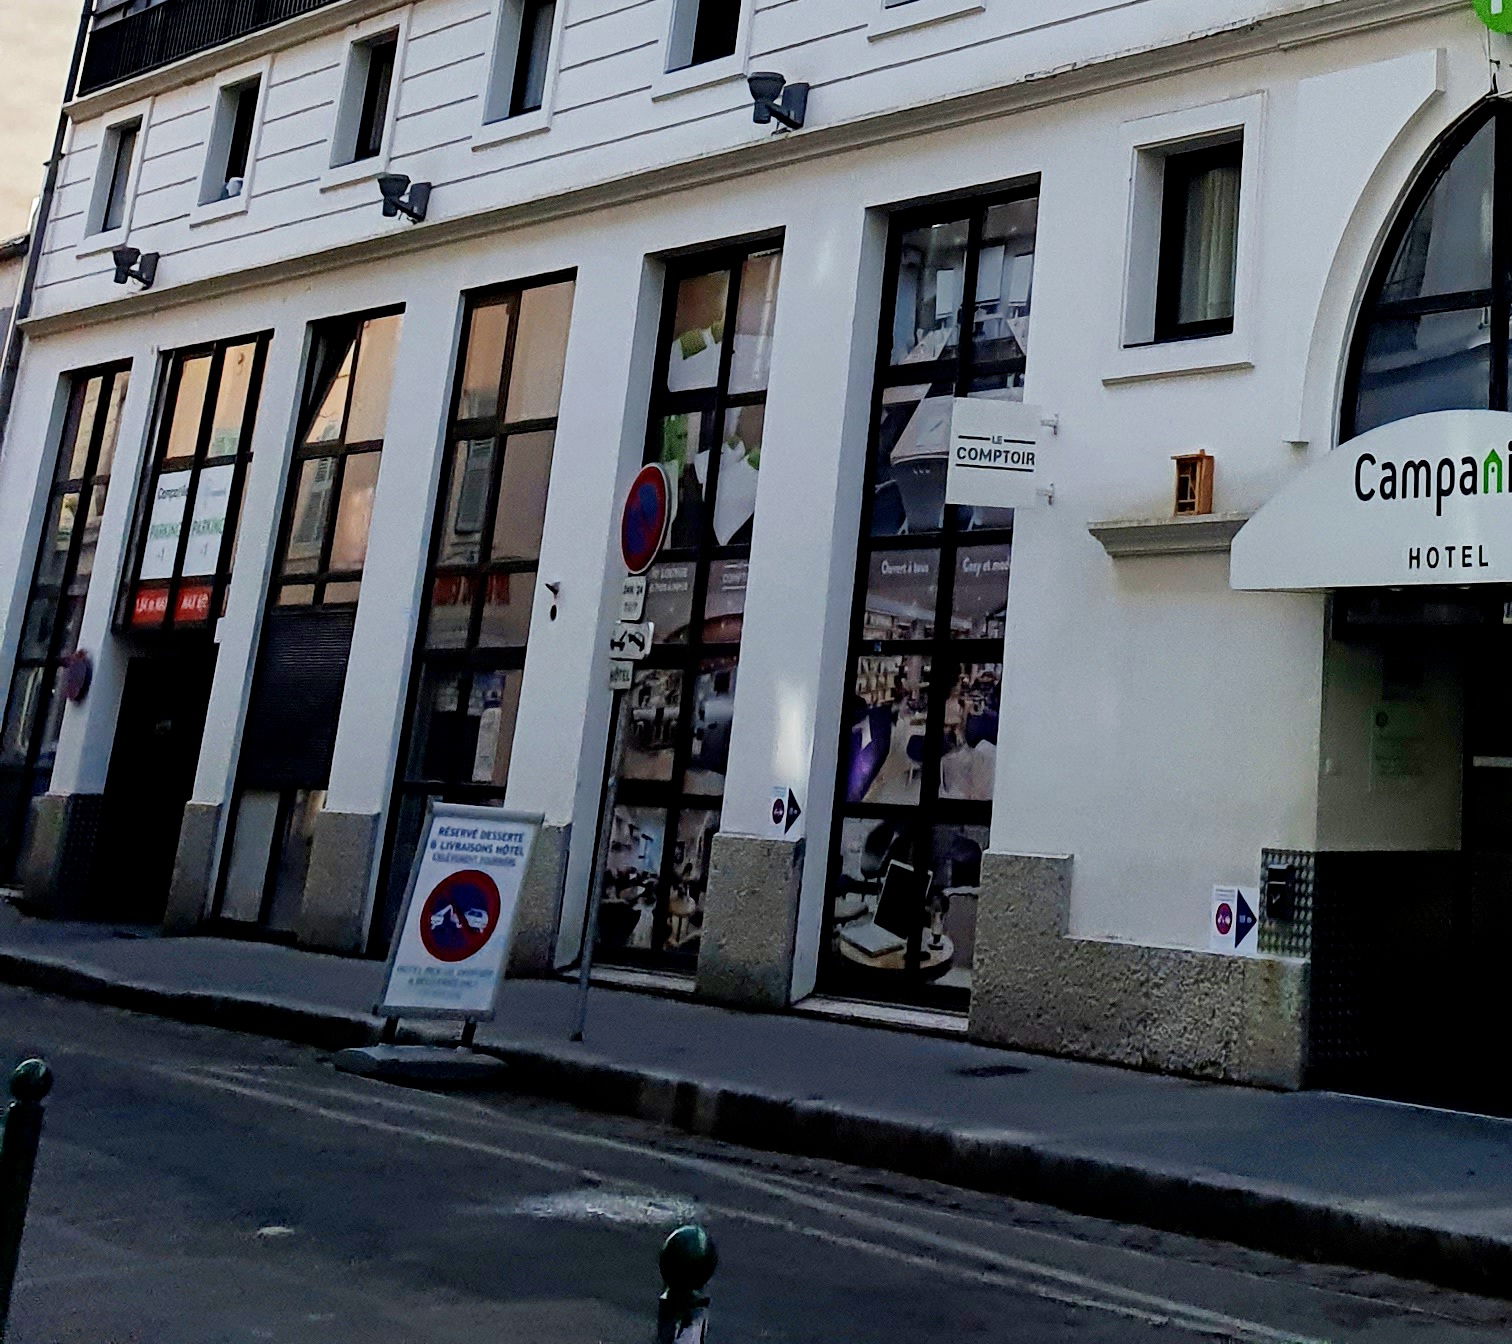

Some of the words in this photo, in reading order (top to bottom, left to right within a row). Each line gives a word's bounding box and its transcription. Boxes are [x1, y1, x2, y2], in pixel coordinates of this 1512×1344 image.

[992, 435, 1003, 445] LE
[956, 446, 1036, 465] COMPTOIR
[1409, 545, 1490, 570] HOTEL
[438, 825, 479, 839] RÉSERVÉ
[480, 829, 525, 843] DESSERTE
[440, 841, 493, 855] LIVRAISONS
